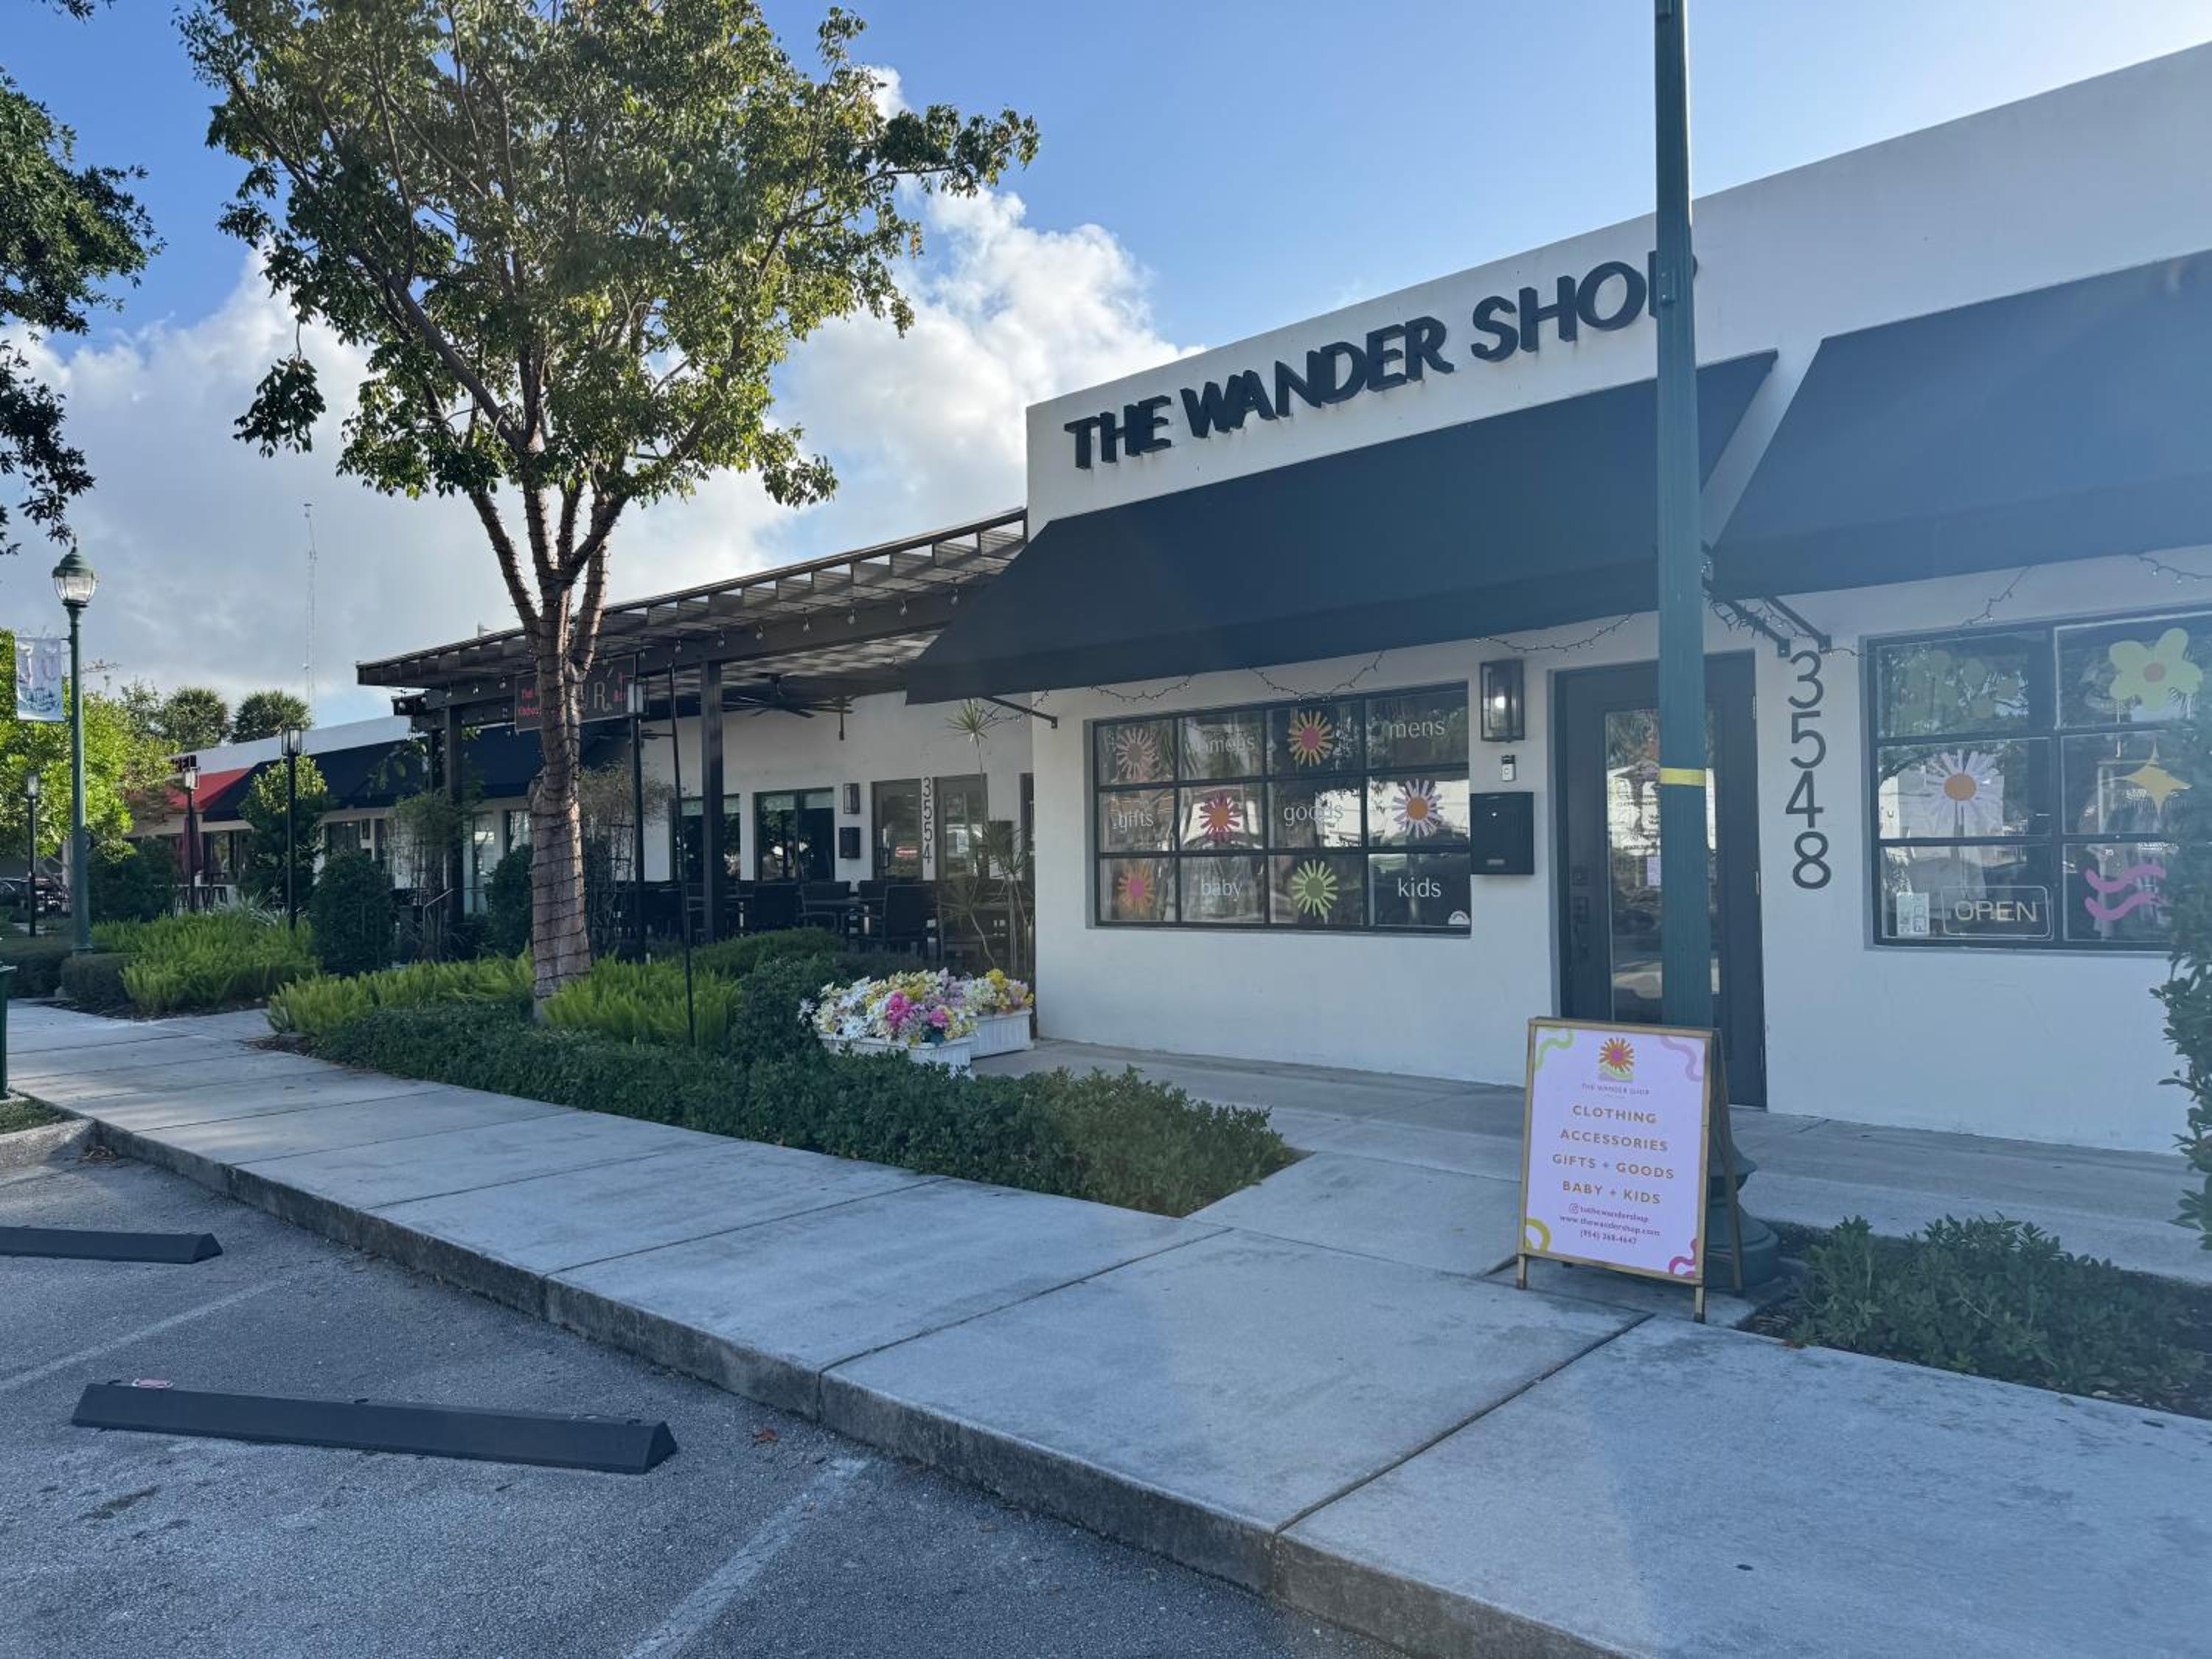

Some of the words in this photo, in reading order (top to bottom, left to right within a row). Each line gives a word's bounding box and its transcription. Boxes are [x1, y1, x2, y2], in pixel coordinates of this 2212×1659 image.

[1064, 394, 1172, 470] THE
[1180, 316, 1455, 439] WANDER
[1389, 719, 1446, 739] mens
[1785, 650, 1832, 890] 3548
[922, 776, 933, 865] 3554
[1119, 809, 1154, 833] gifts
[1284, 801, 1344, 827] goods
[1200, 880, 1243, 902] baby
[1397, 877, 1442, 898] kids
[1955, 900, 2038, 922] OPEN
[1572, 1105, 1657, 1124] CLOTHING
[1559, 1128, 1669, 1152] ACCESSORIES
[1552, 1153, 1596, 1169] GIFTS
[1616, 1162, 1674, 1180] GOODS
[1562, 1180, 1603, 1196] BABY
[1623, 1189, 1660, 1204] KIDS
